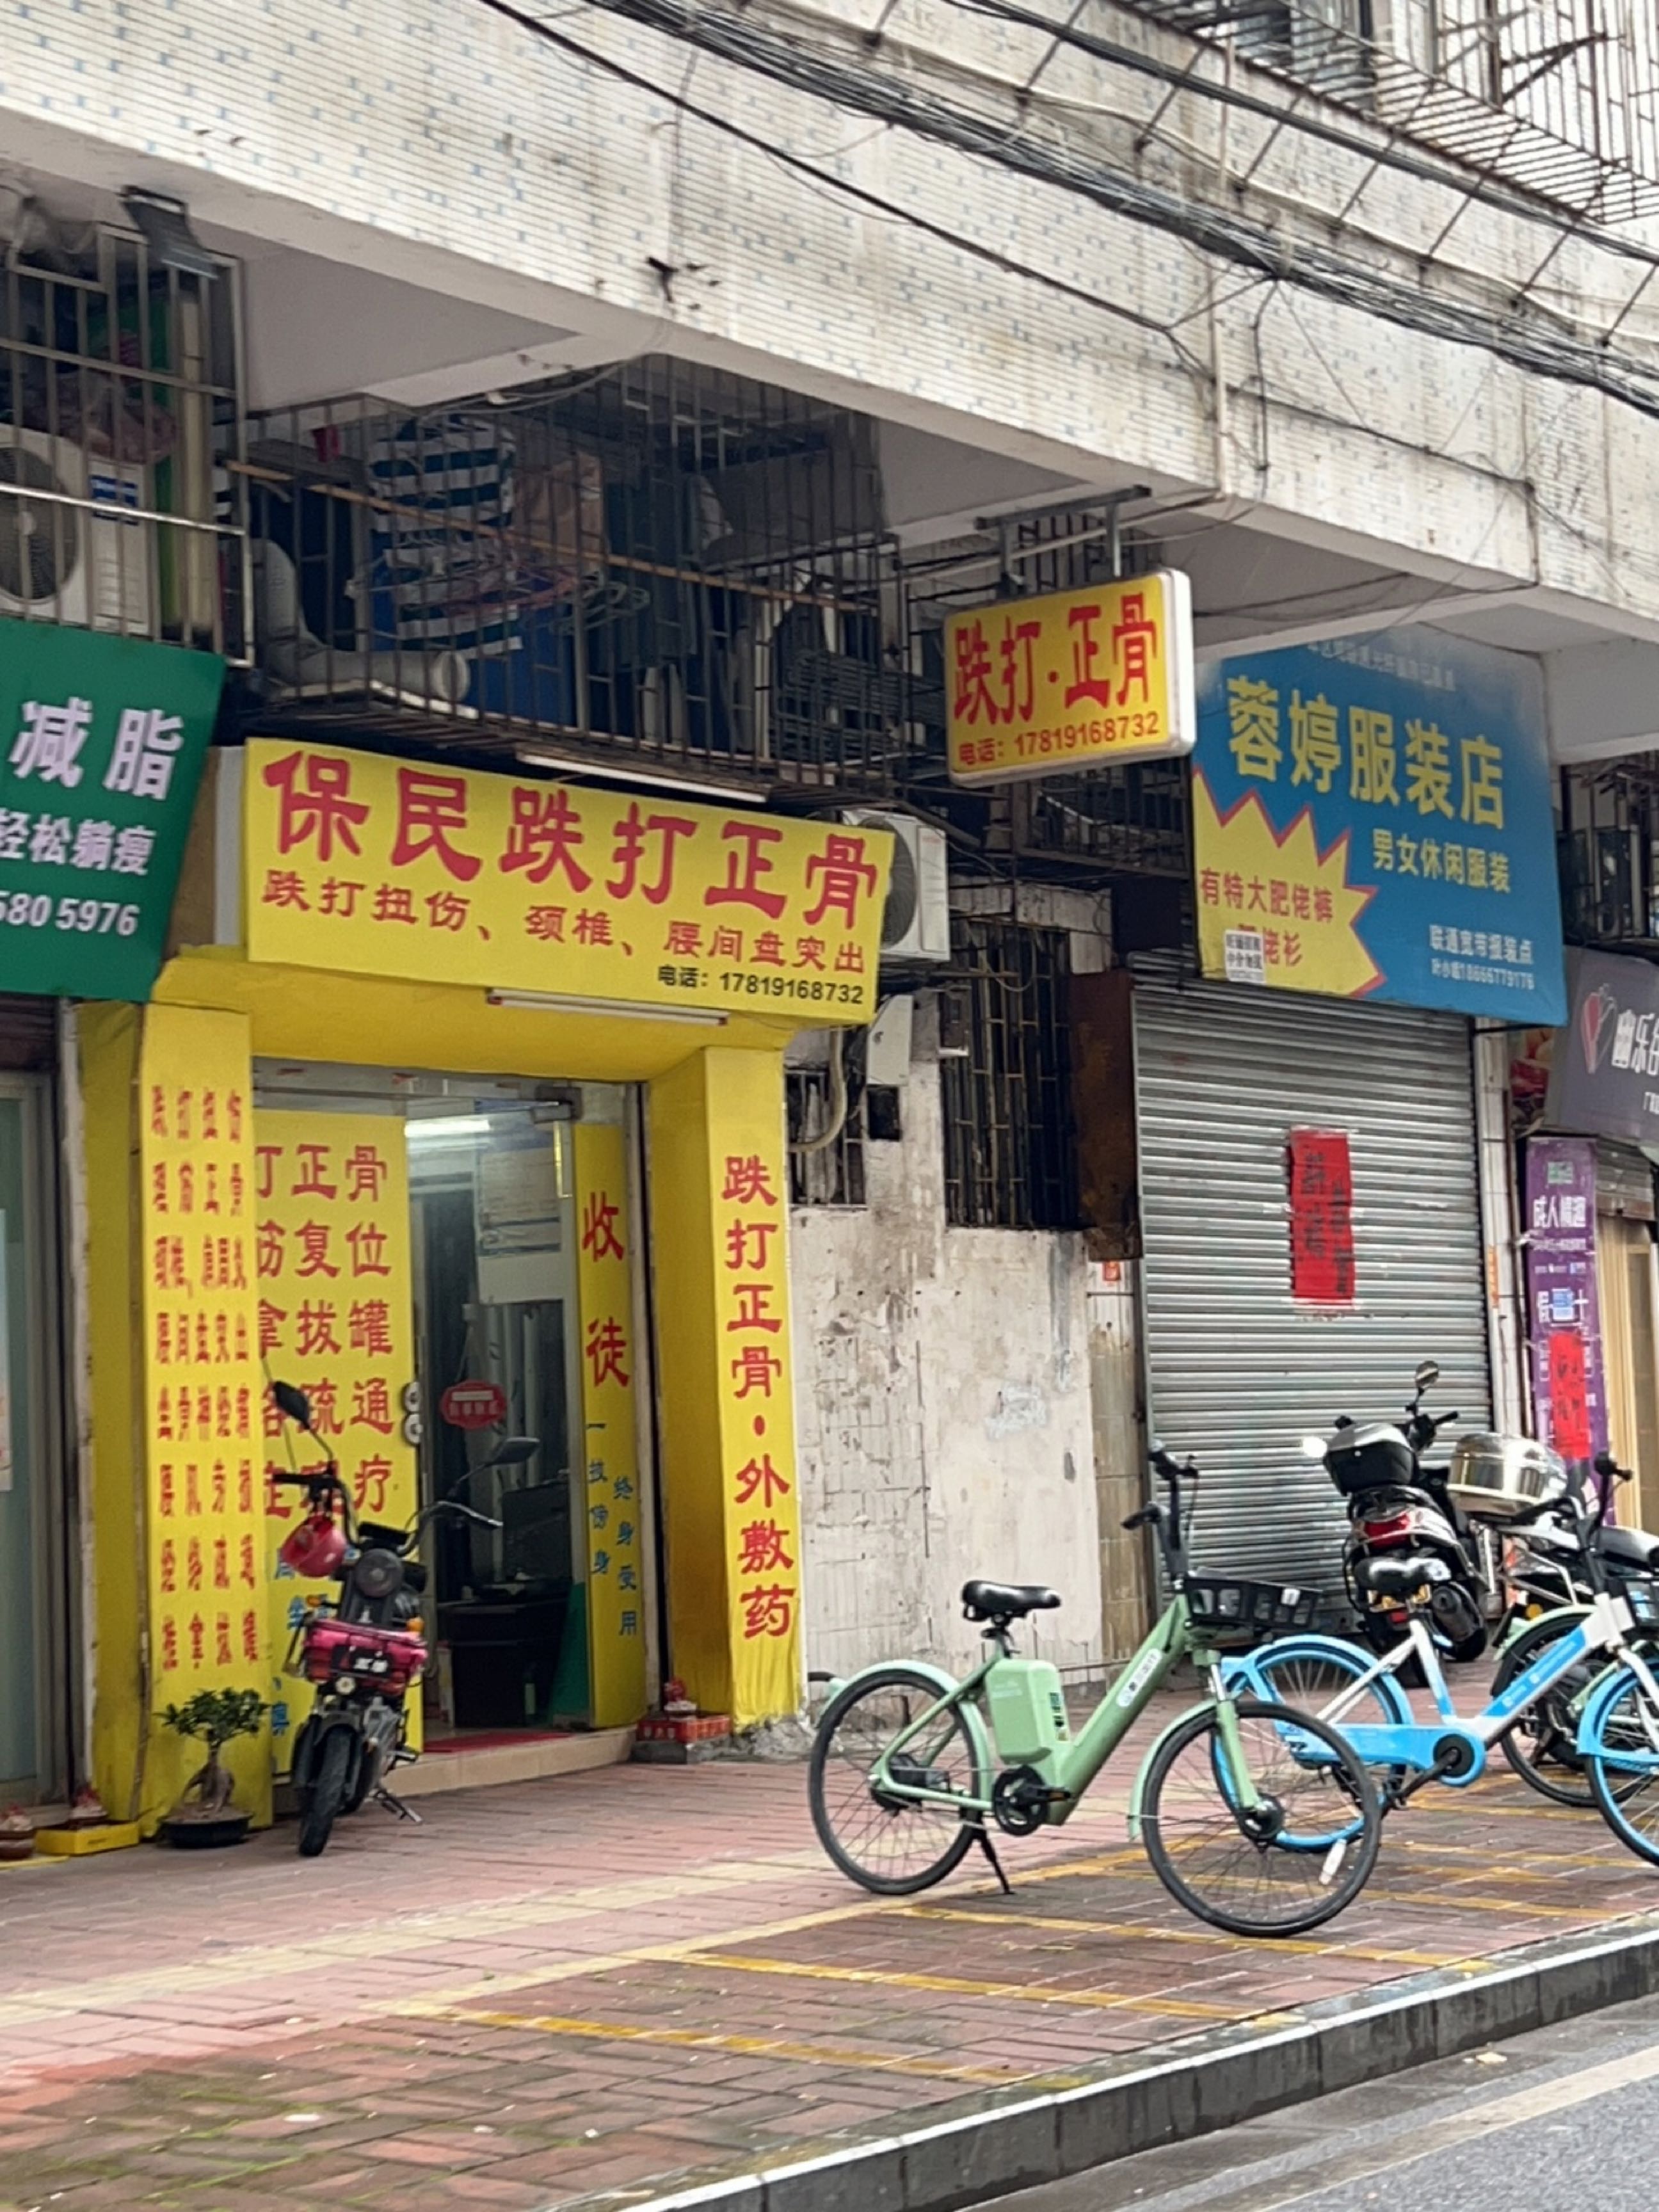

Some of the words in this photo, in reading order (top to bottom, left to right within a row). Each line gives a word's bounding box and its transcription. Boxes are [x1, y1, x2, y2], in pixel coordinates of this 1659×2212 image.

[8, 697, 184, 800] 减脂
[1227, 675, 1505, 829] 蓉婷服装店
[0, 808, 156, 876] 轻松躺瘦
[263, 750, 878, 929] 保民跌打正骨
[1373, 828, 1511, 894] 男女休闲服装
[55, 898, 140, 936] 5976
[582, 1191, 630, 1388] 收徒
